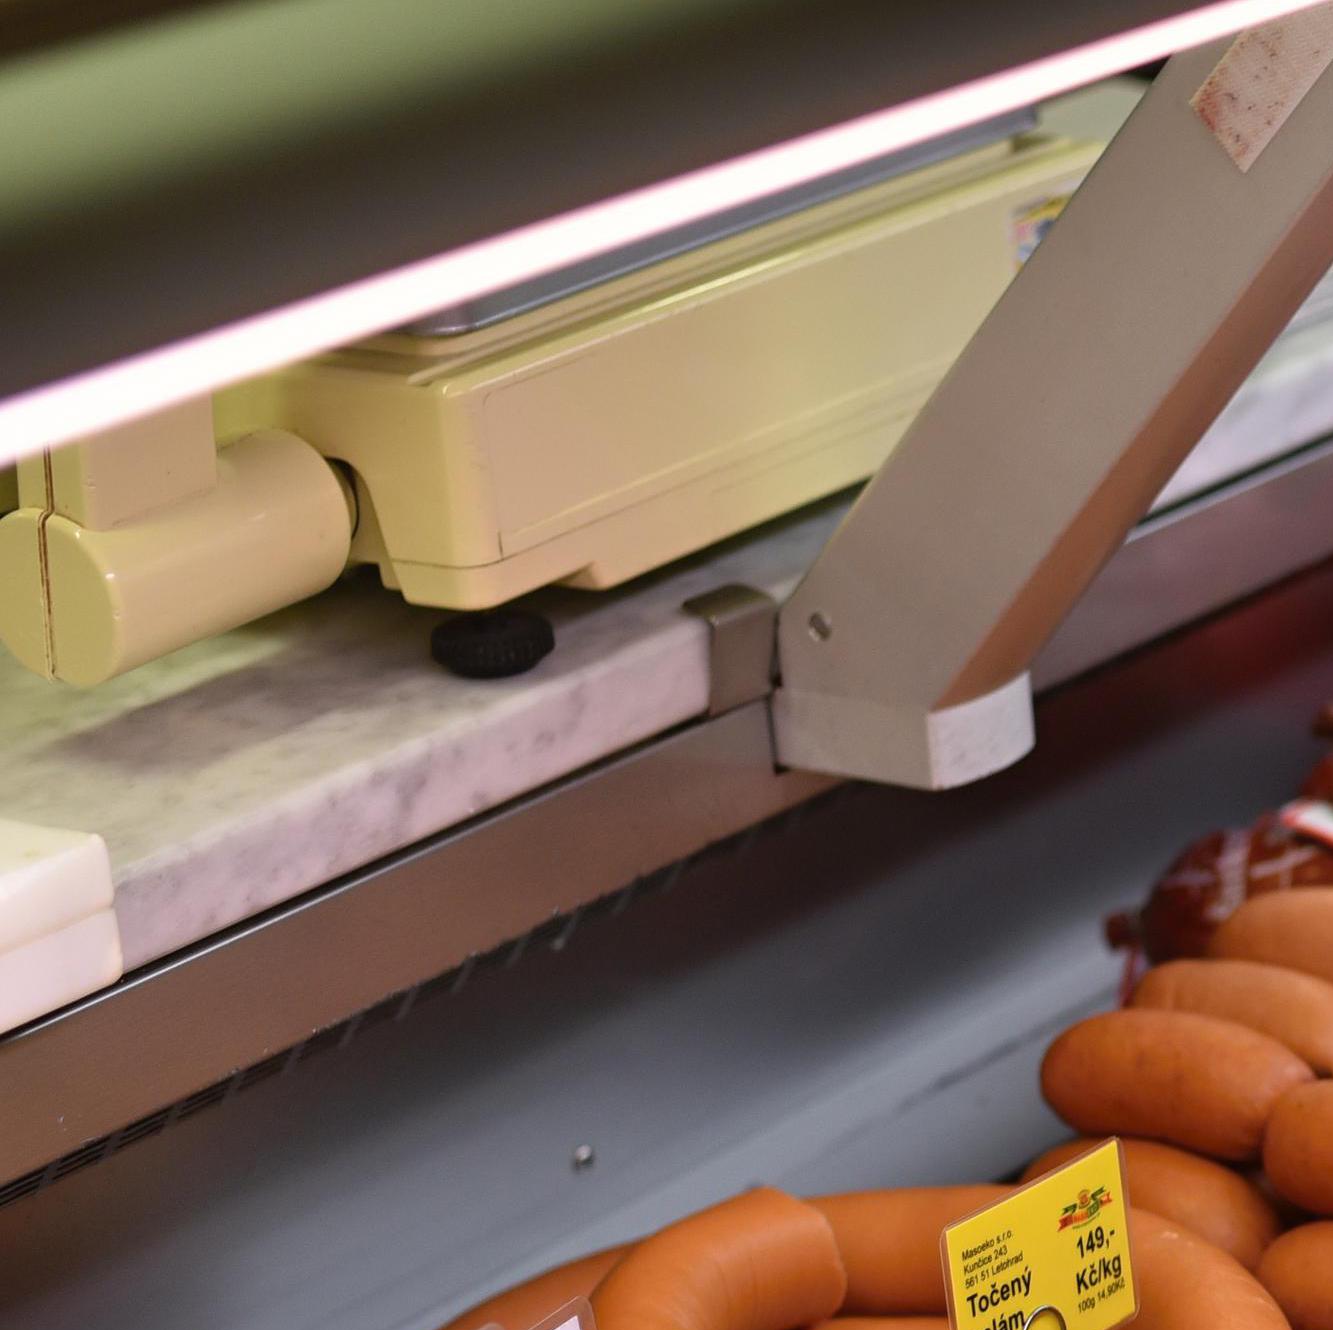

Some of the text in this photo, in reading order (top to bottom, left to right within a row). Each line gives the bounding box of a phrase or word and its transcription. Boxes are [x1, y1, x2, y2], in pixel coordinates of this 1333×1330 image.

[993, 1245, 1008, 1262] 243
[1076, 1225, 1116, 1260] 149,-
[966, 1265, 1033, 1319] Točený
[1075, 1253, 1122, 1295] Kč/kg
